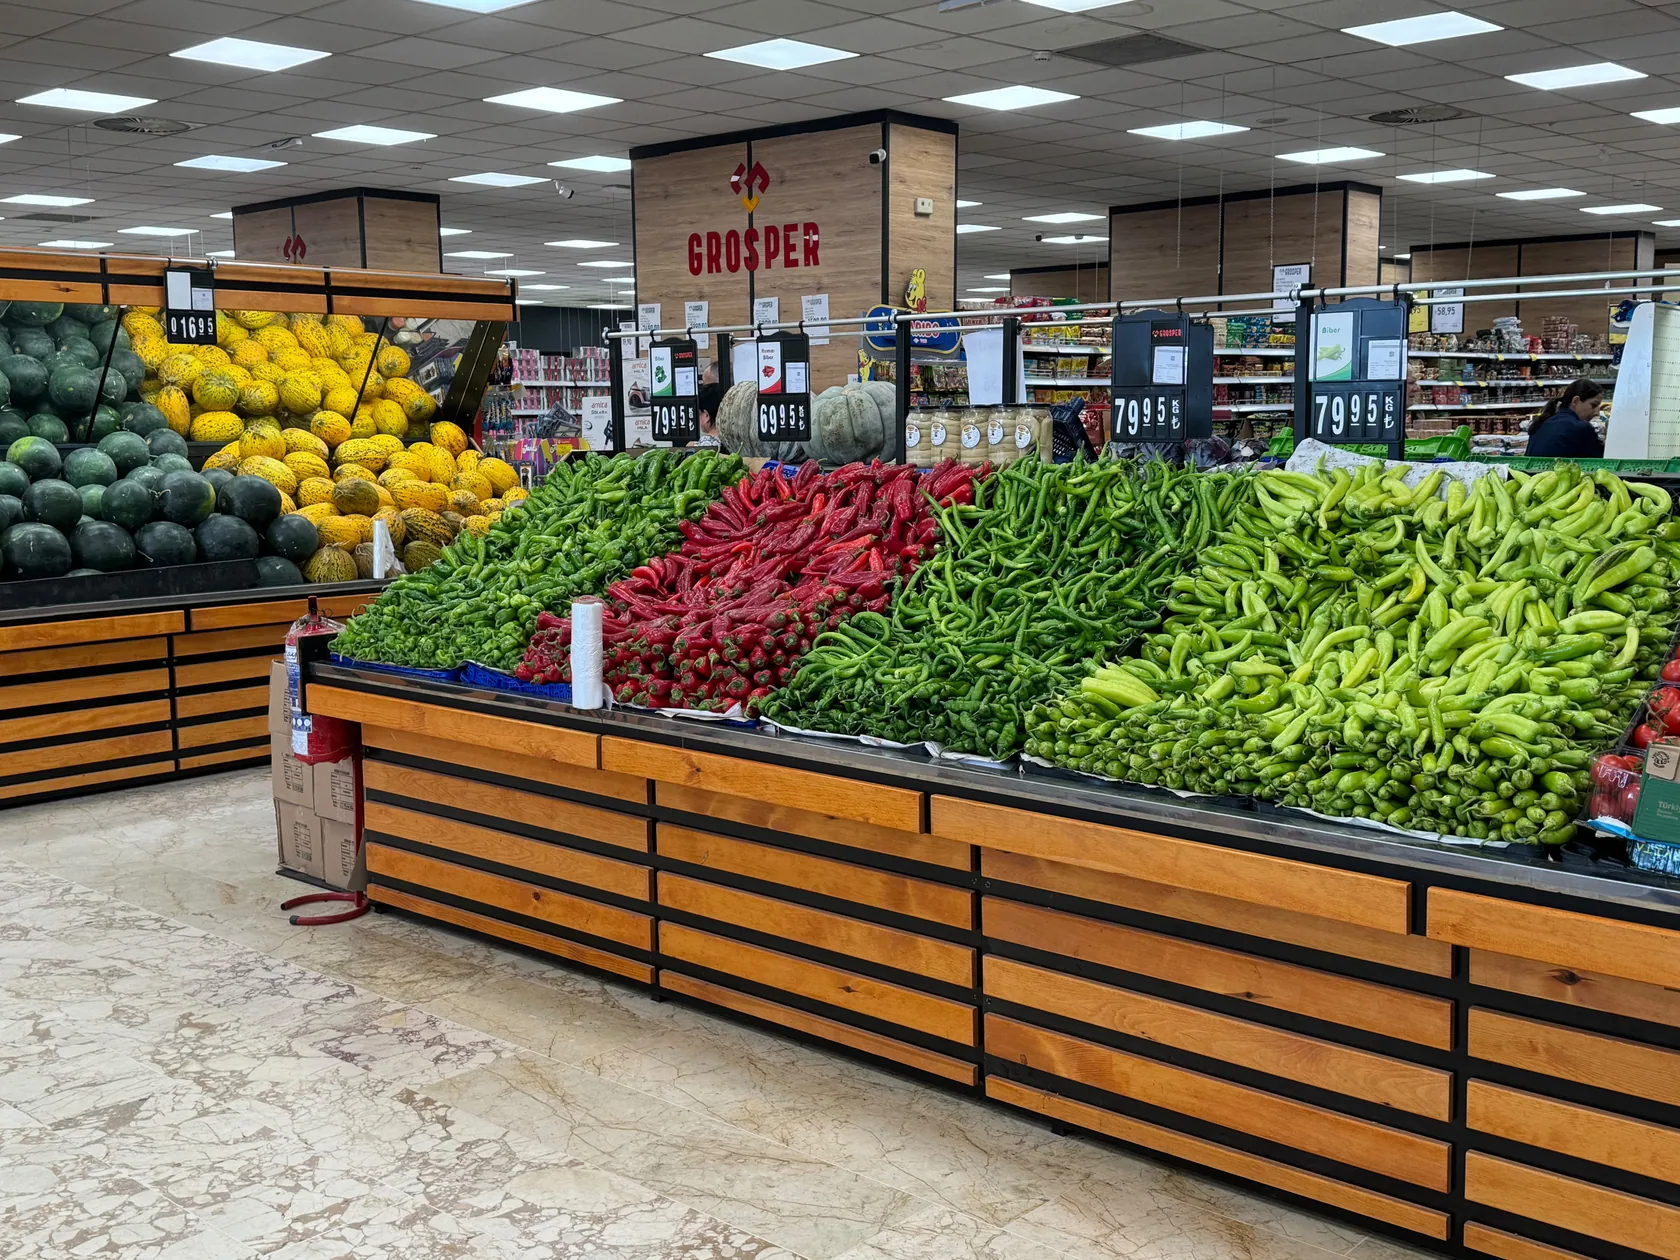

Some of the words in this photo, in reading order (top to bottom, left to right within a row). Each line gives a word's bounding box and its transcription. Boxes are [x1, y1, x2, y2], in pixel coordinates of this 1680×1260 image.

[688, 221, 820, 276] GROSPER
[1159, 328, 1183, 338] GROSPER
[1321, 326, 1341, 334] Biber
